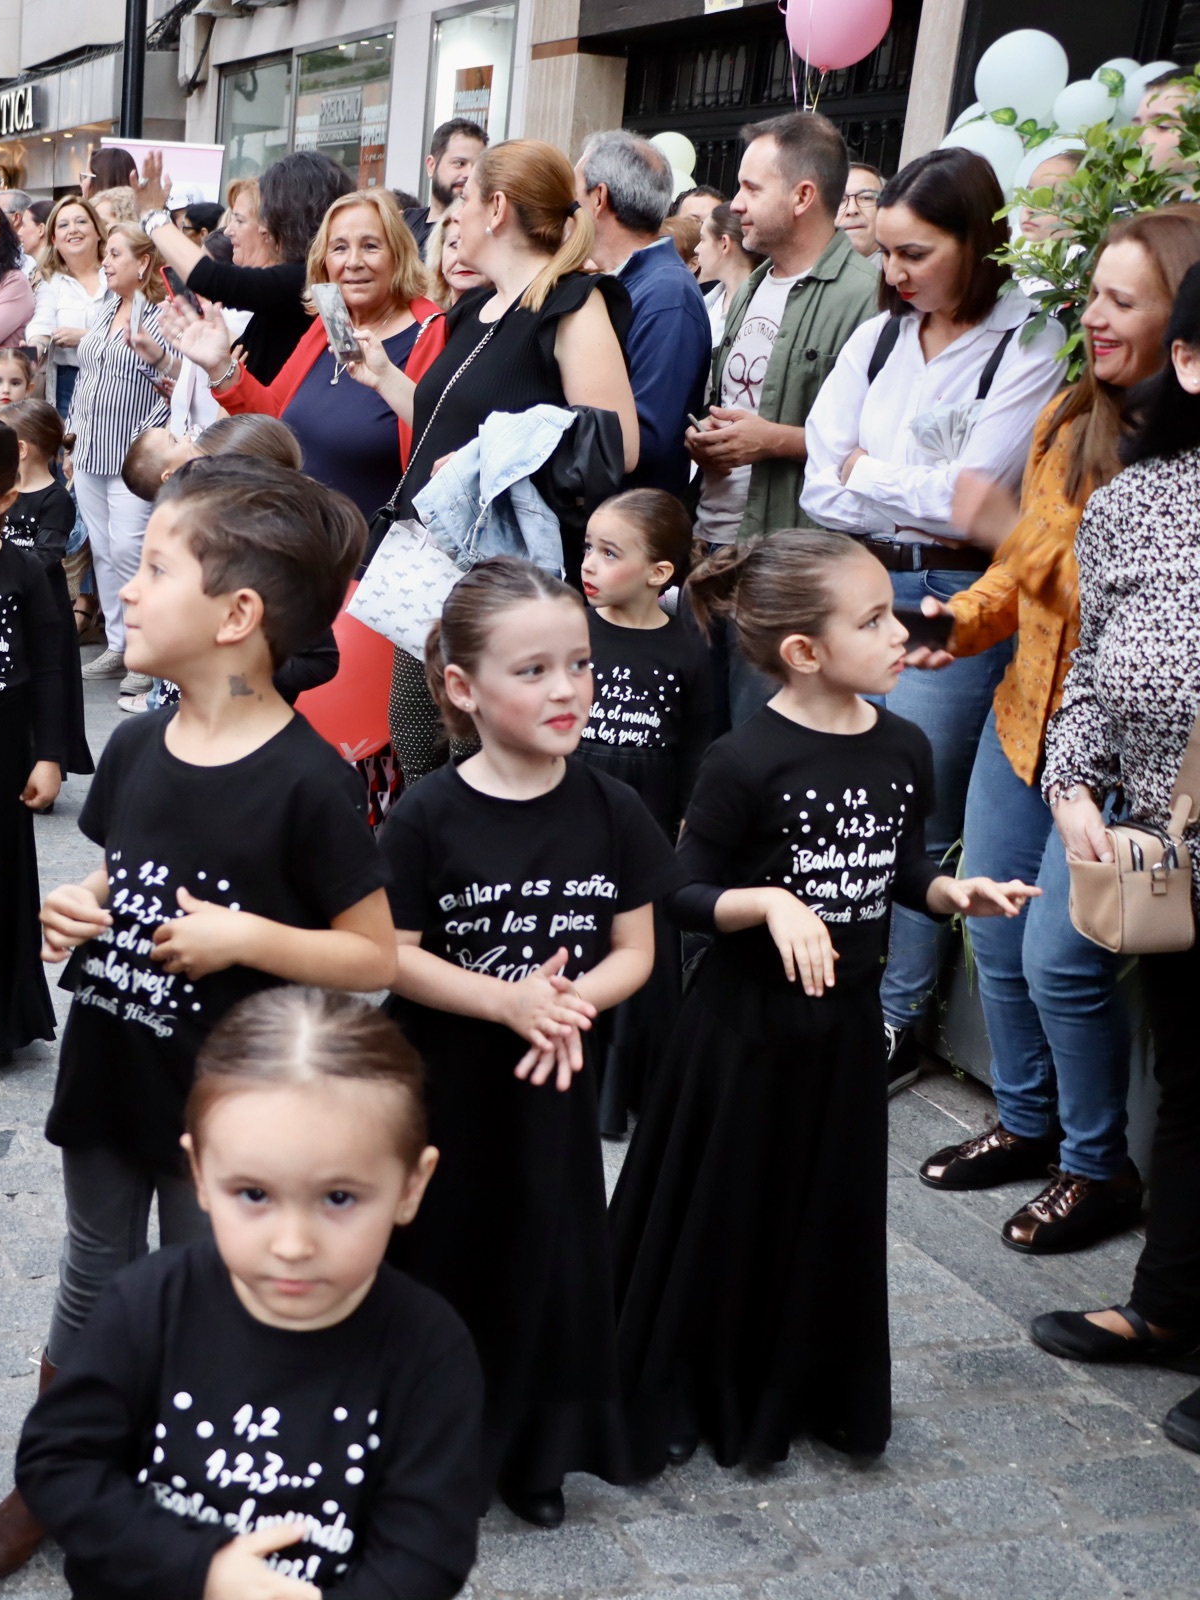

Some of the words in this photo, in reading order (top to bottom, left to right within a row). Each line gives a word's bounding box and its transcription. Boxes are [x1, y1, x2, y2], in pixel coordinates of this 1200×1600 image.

[612, 666, 631, 681] 1,2
[607, 704, 622, 720] el
[622, 710, 661, 728] mundo
[597, 721, 616, 744] los
[618, 729, 650, 747] pies!
[843, 788, 868, 810] 1,2
[792, 844, 846, 875] ¡Baila
[848, 842, 867, 868] el
[138, 861, 169, 886] 1,2
[805, 879, 838, 899] con
[840, 871, 865, 901] los
[438, 882, 511, 911] Bailar
[521, 879, 551, 896] es
[116, 924, 138, 950] el
[445, 916, 491, 936] con
[501, 910, 537, 933] los
[549, 909, 597, 938] pies.
[105, 950, 131, 990] los
[132, 968, 176, 1005] pies!
[233, 1403, 281, 1443] 1,2
